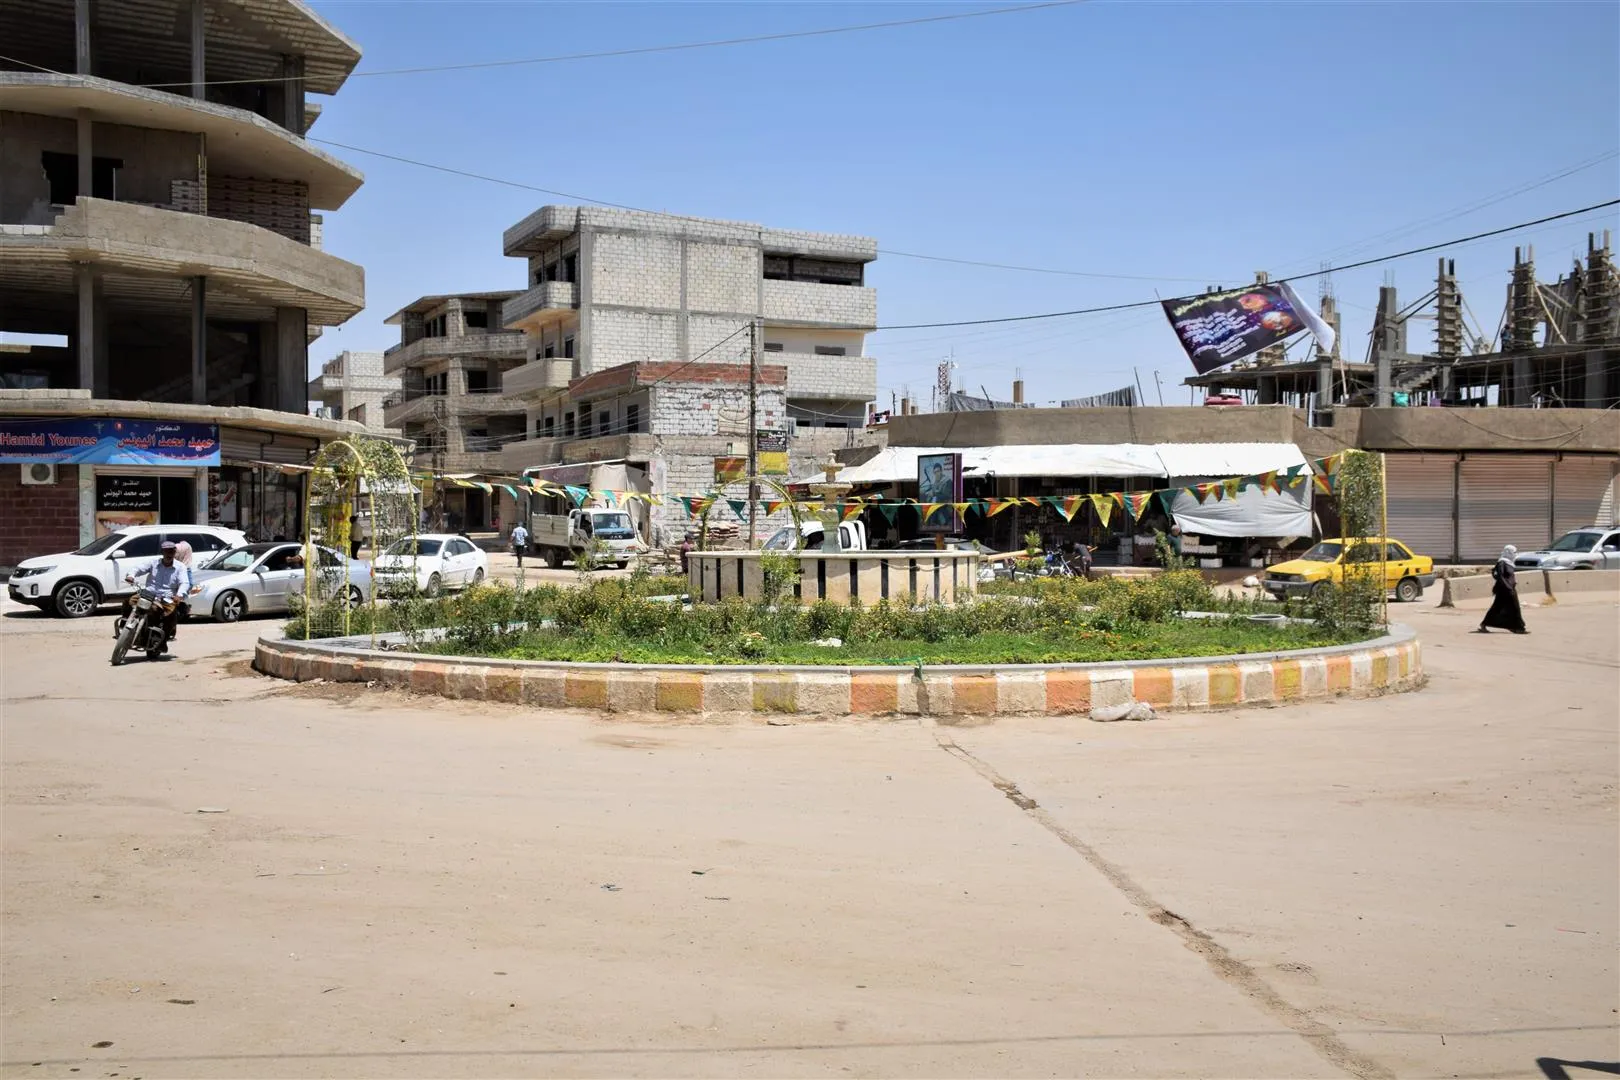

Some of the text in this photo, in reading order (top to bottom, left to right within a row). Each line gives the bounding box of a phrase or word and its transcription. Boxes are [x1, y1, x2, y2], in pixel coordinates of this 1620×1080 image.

[0, 432, 97, 446] Hamid Younes
[116, 432, 215, 452] حميد محمد اليونس
[103, 489, 122, 498] اليونس
